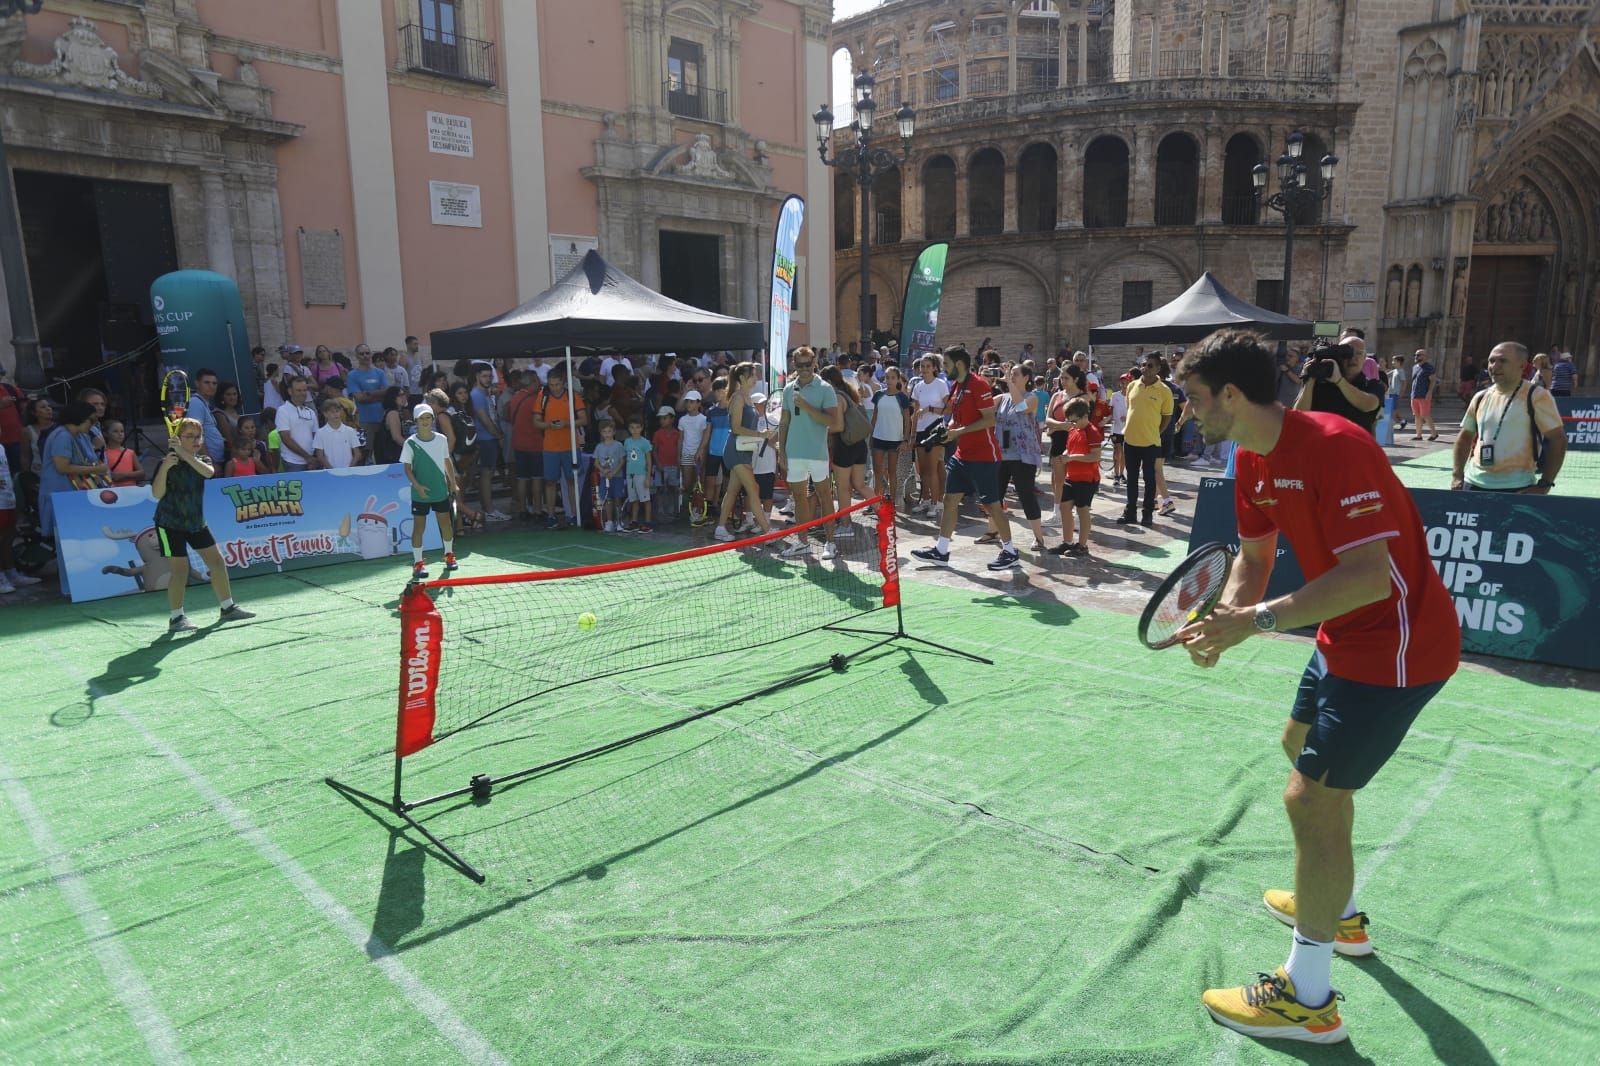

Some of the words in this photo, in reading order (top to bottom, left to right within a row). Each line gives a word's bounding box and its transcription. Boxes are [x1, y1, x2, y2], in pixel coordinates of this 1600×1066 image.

[166, 311, 193, 322] CUP
[1204, 479, 1218, 489] ITF
[235, 500, 304, 523] HEALTH
[1445, 512, 1479, 527] THE
[224, 535, 282, 568] Street
[280, 532, 334, 559] Tennis
[886, 526, 896, 574] Wilson
[1423, 526, 1535, 565] ORLD
[1431, 560, 1483, 593] UP
[1479, 582, 1503, 597] OF
[1451, 596, 1525, 635] NIS
[408, 626, 430, 697] Wilson
